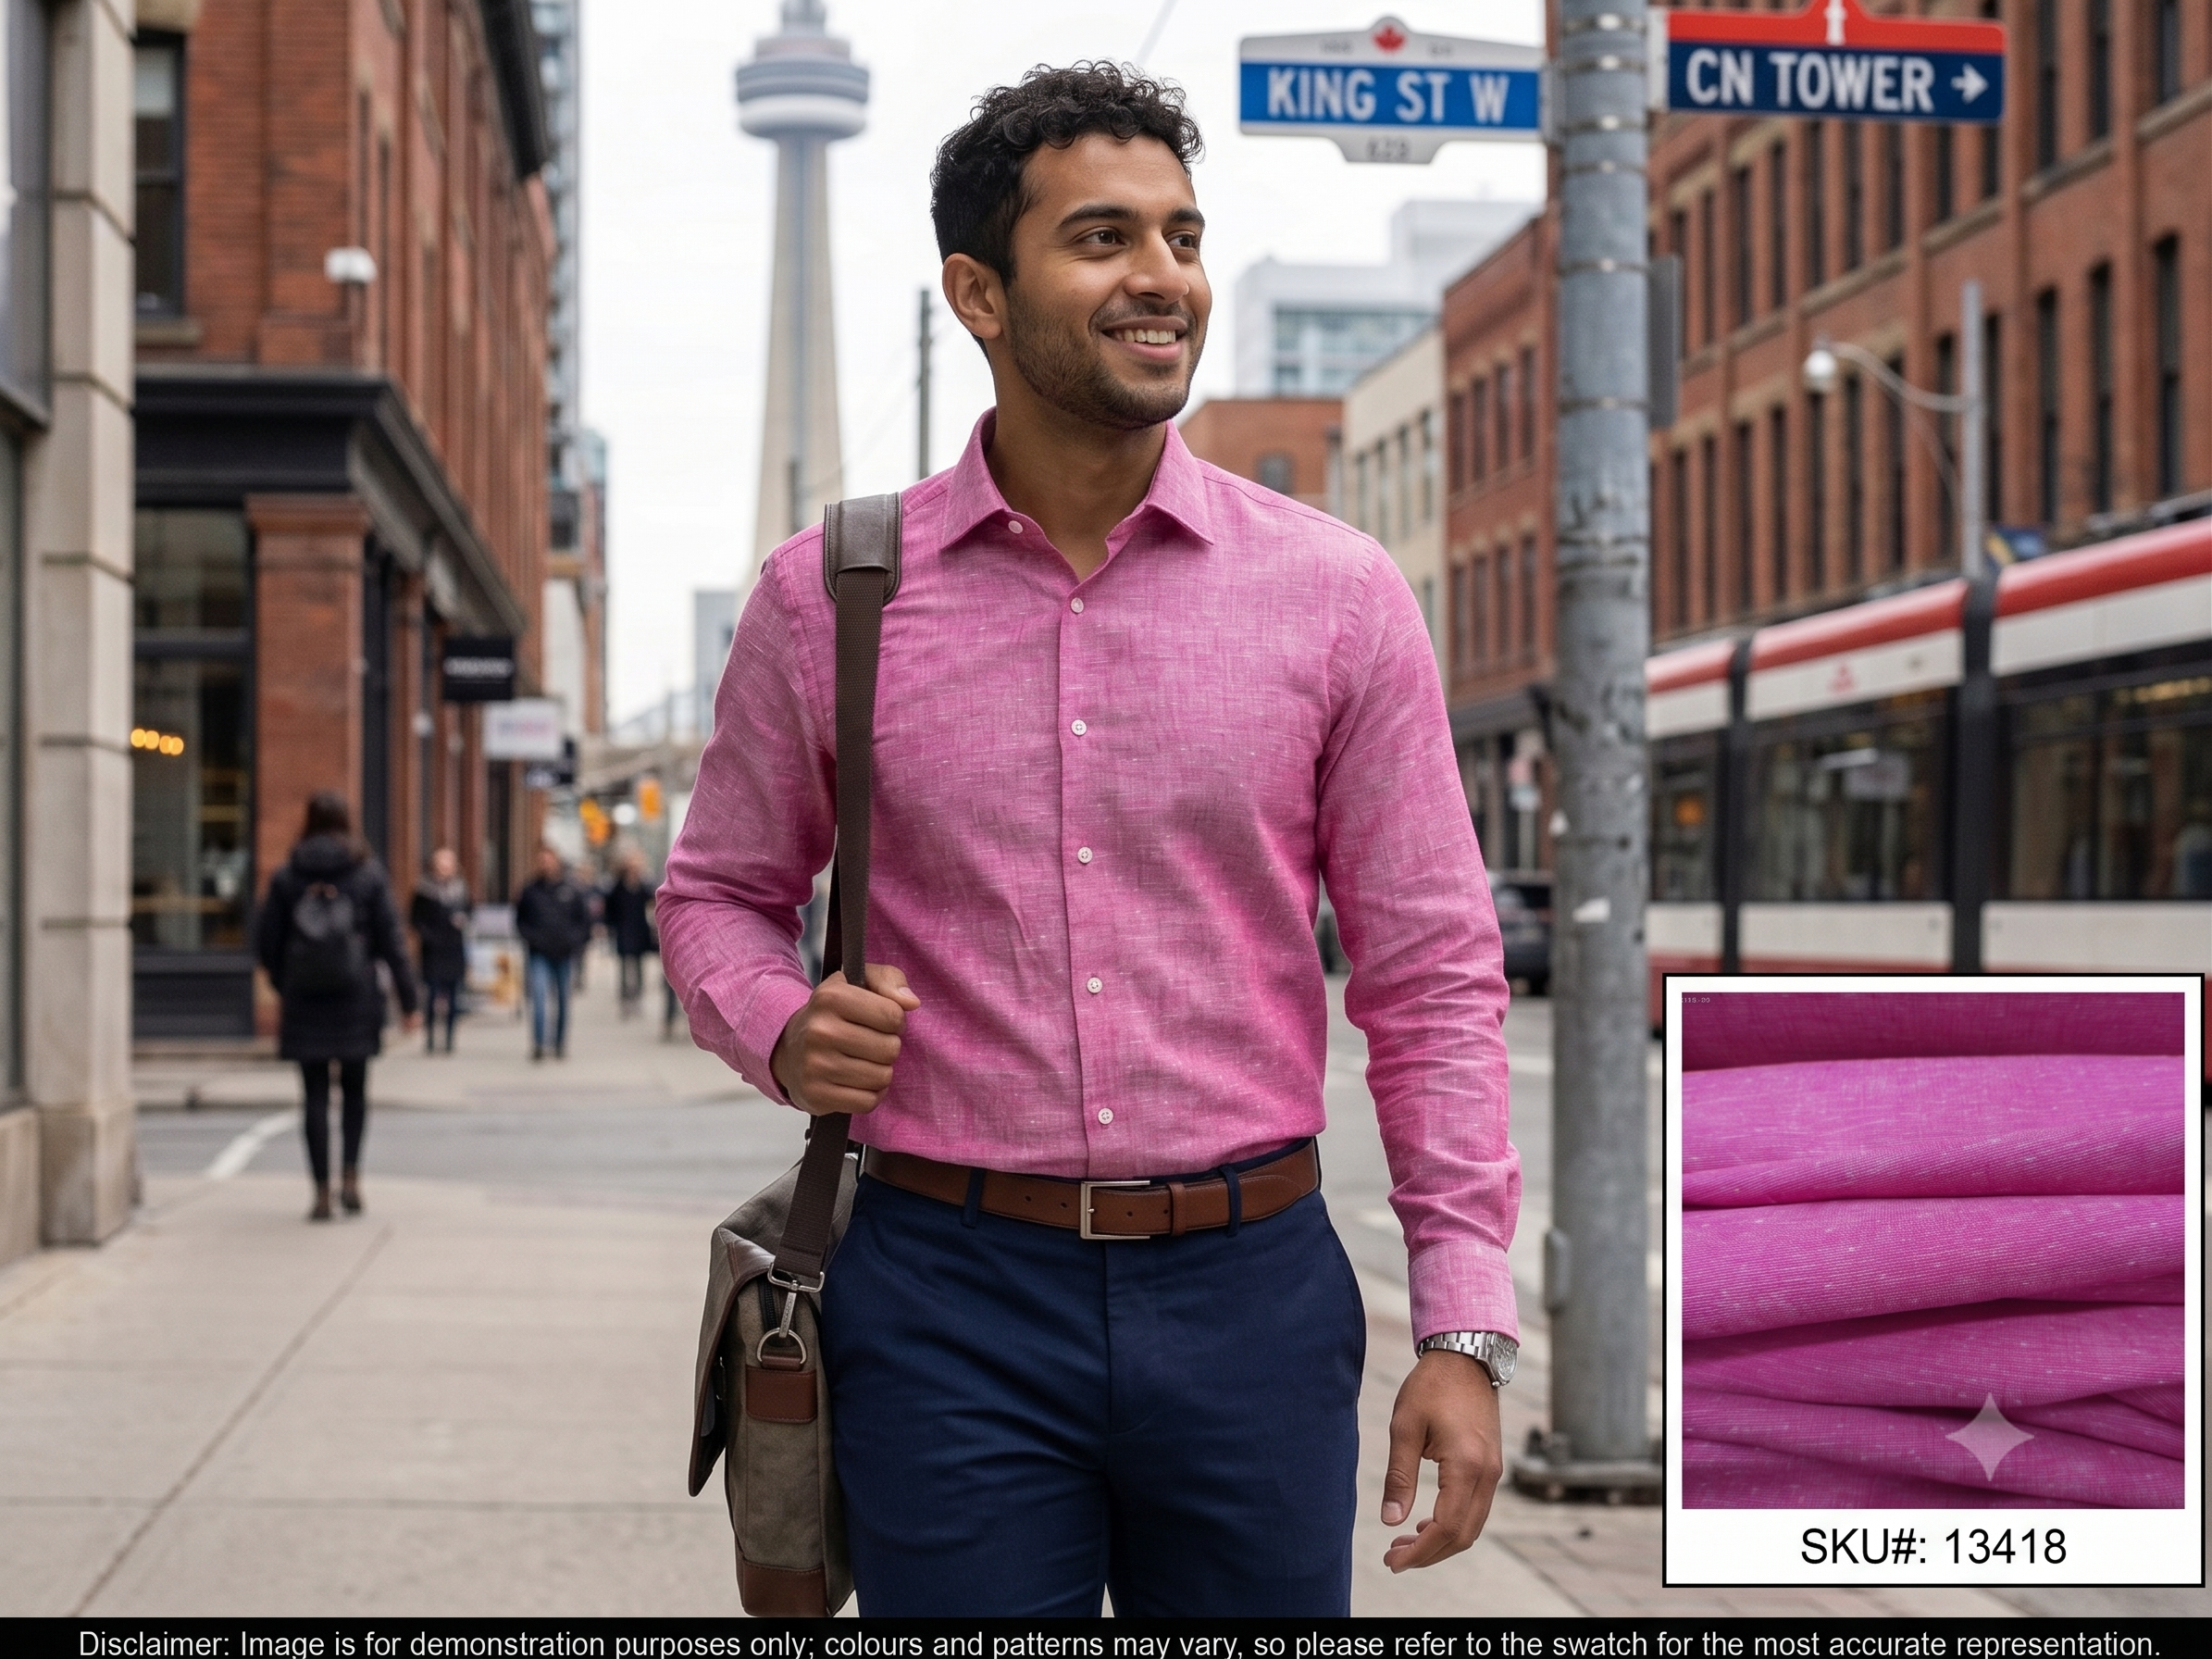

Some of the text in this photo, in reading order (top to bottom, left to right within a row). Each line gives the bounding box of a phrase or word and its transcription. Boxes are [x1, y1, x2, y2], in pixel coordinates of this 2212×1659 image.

[1266, 66, 1510, 124] KING ST W
[1686, 48, 1934, 114] CN TOWER
